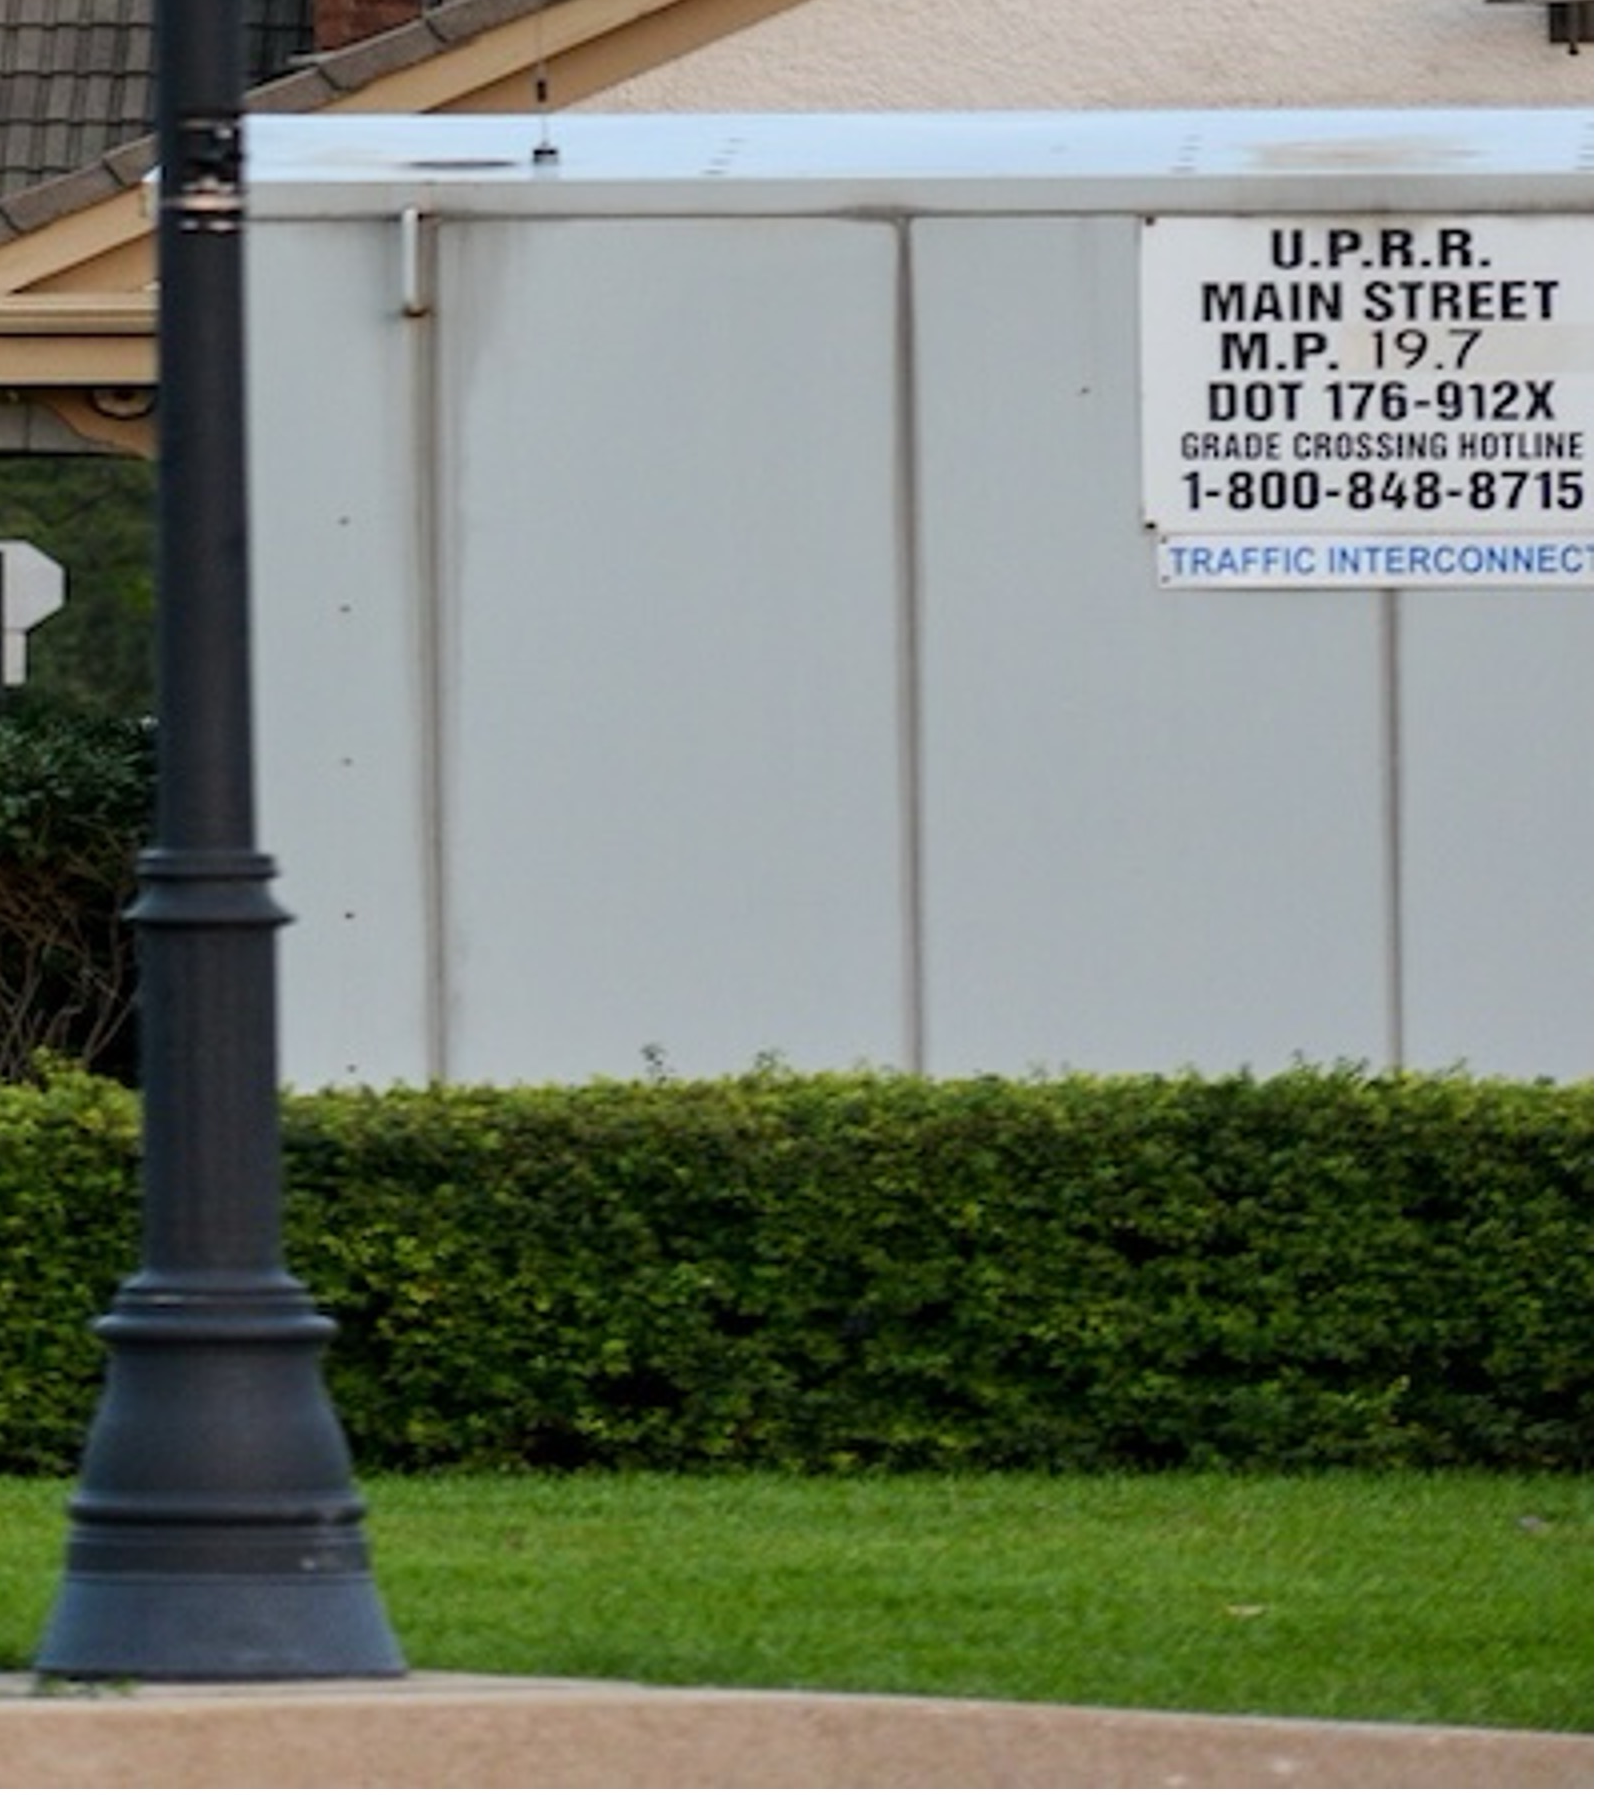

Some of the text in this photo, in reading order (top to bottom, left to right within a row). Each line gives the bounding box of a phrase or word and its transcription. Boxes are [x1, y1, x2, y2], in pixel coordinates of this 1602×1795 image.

[1270, 229, 1491, 270] U.P.R.R.
[1201, 281, 1559, 322] MAIN STREET
[1220, 329, 1483, 370] M.P. 19.7
[1208, 380, 1556, 422] DOT 176-912X
[1180, 432, 1584, 461] GRADE CROSSING HOTLINE
[1182, 470, 1584, 511] 1-800-848-8715
[1169, 545, 1316, 575] TRAFFIC
